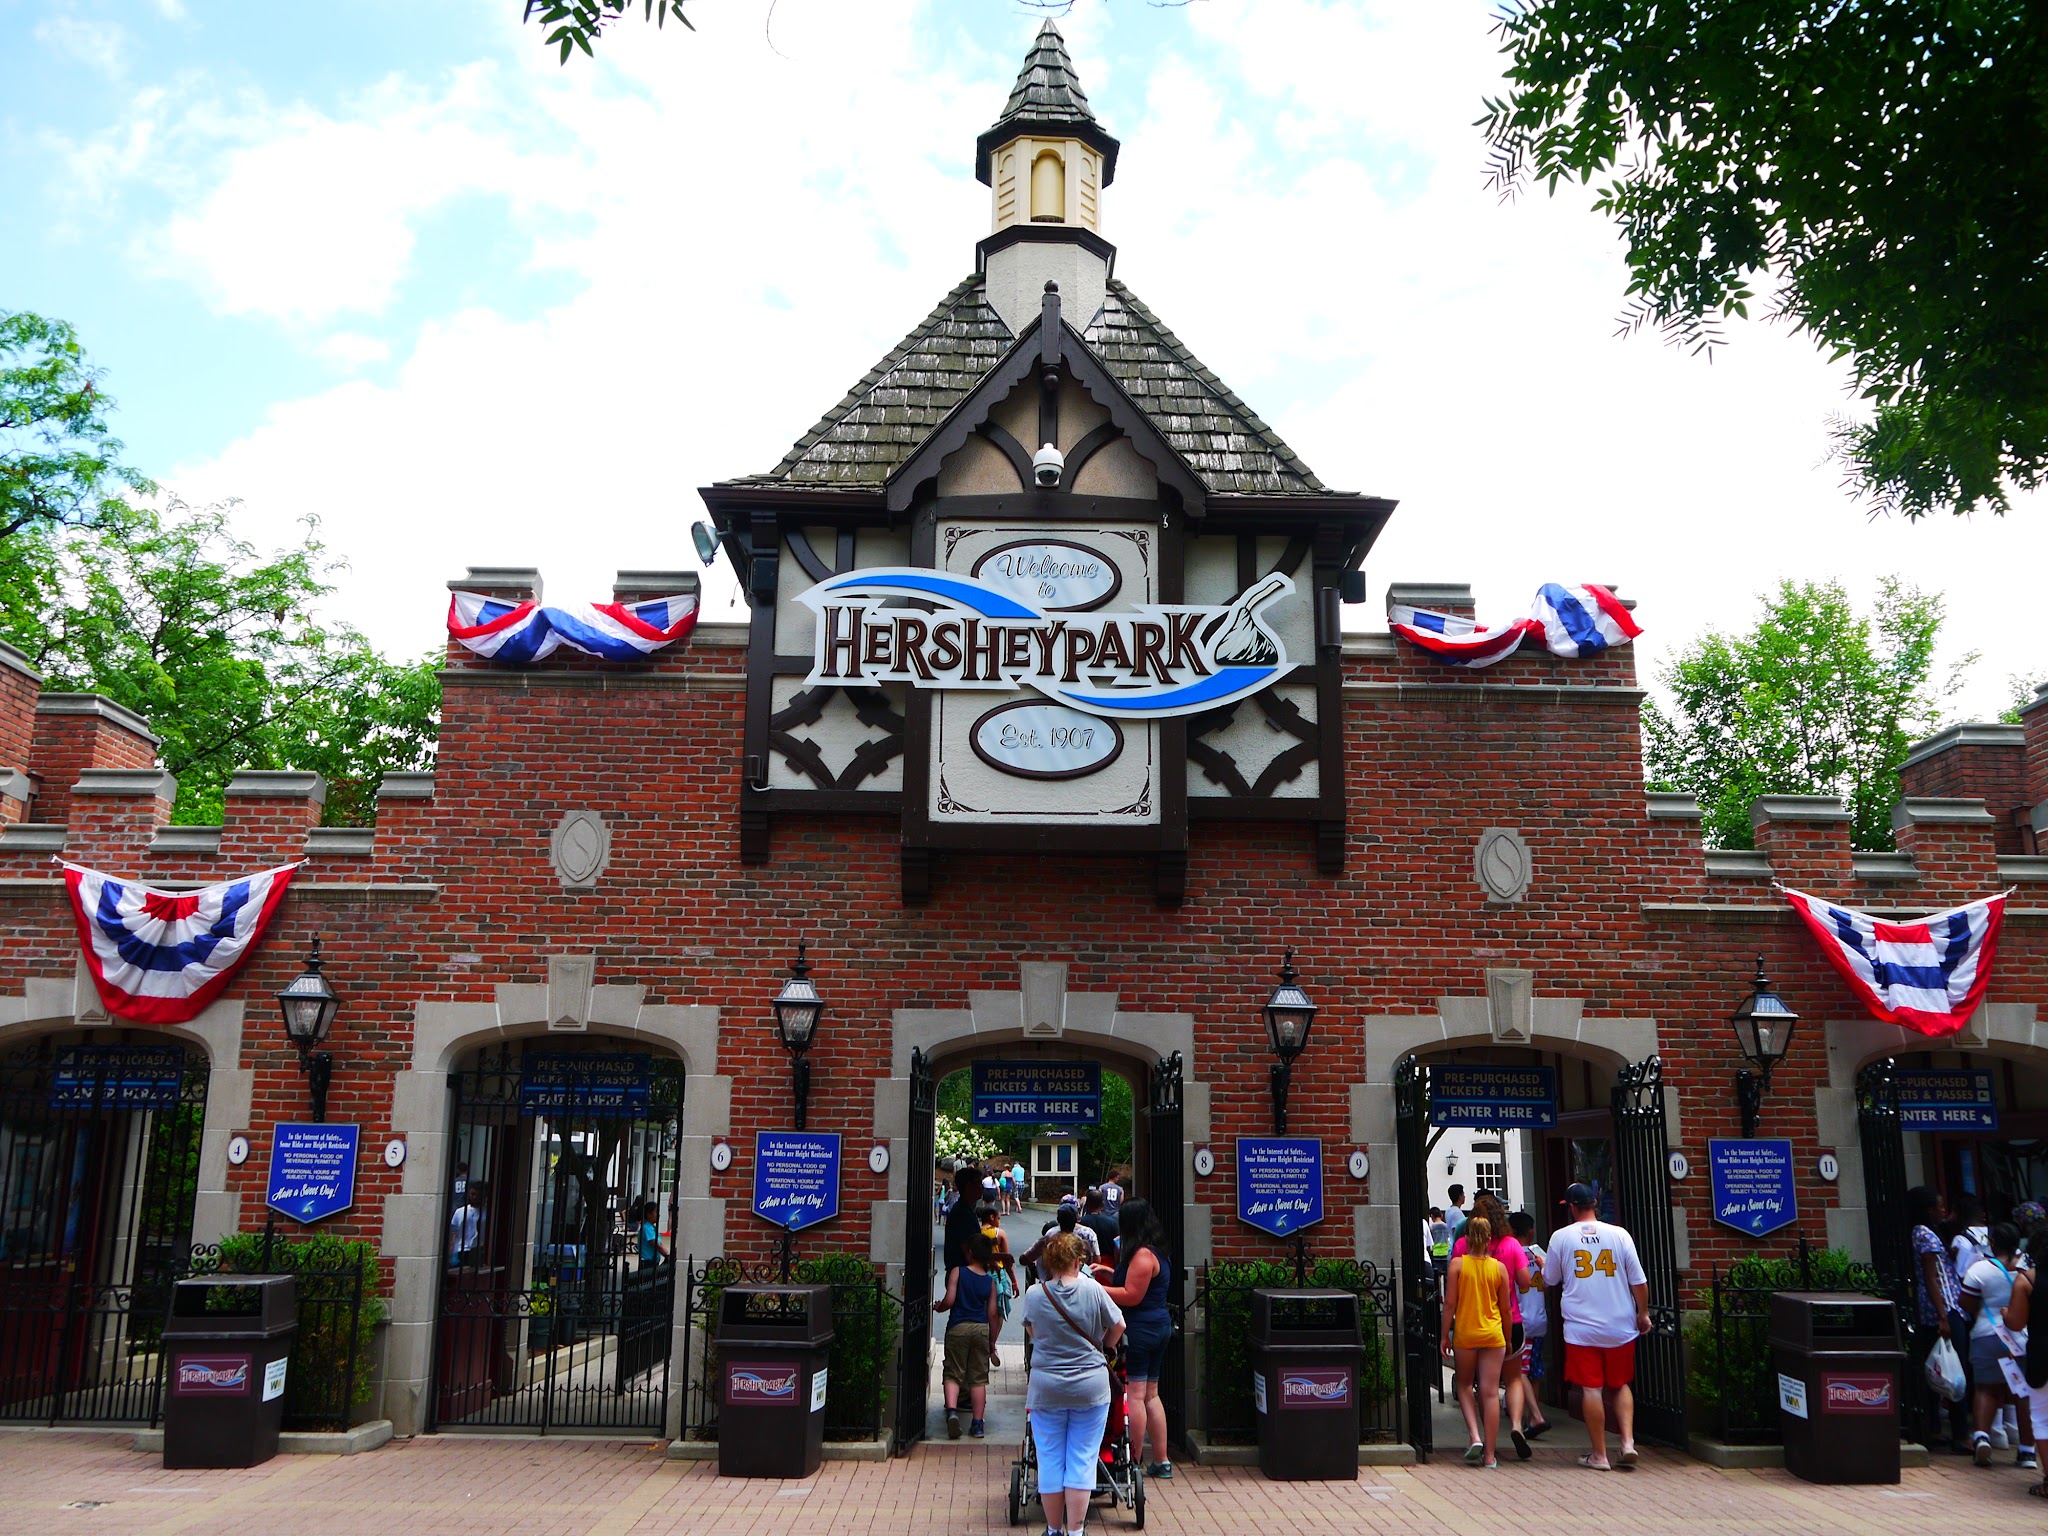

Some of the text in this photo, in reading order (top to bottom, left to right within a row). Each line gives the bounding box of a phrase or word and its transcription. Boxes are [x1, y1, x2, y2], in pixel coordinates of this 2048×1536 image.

[996, 552, 1098, 580] Welcome
[1036, 580, 1056, 599] to
[998, 723, 1096, 750] Est. 1907
[988, 1069, 1085, 1079] PRE-PURCHASED
[1444, 1073, 1540, 1084] PRE-PURCHASED
[983, 1082, 1090, 1092] TICKETS & PASSES
[1440, 1086, 1545, 1097] TICKETS & PASSES
[1924, 1090, 1931, 1099] &
[1936, 1090, 1974, 1100] PASSES
[994, 1102, 1078, 1113] ENTER HERE
[1450, 1106, 1533, 1118] ENTER HERE
[1943, 1110, 1976, 1121] HERE
[234, 1144, 240, 1156] 4
[313, 1142, 327, 1150] Height
[391, 1148, 398, 1159] 5
[717, 1151, 724, 1162] 6
[795, 1150, 809, 1159] Height
[876, 1153, 882, 1164] 7
[1201, 1156, 1208, 1168] 8
[1278, 1156, 1292, 1164] Height
[1356, 1158, 1362, 1170] 9
[1750, 1157, 1764, 1165] Height
[1673, 1160, 1684, 1172] 10
[1824, 1161, 1834, 1172] 11
[1106, 1188, 1118, 1201] 18
[1574, 1249, 1616, 1278] 34
